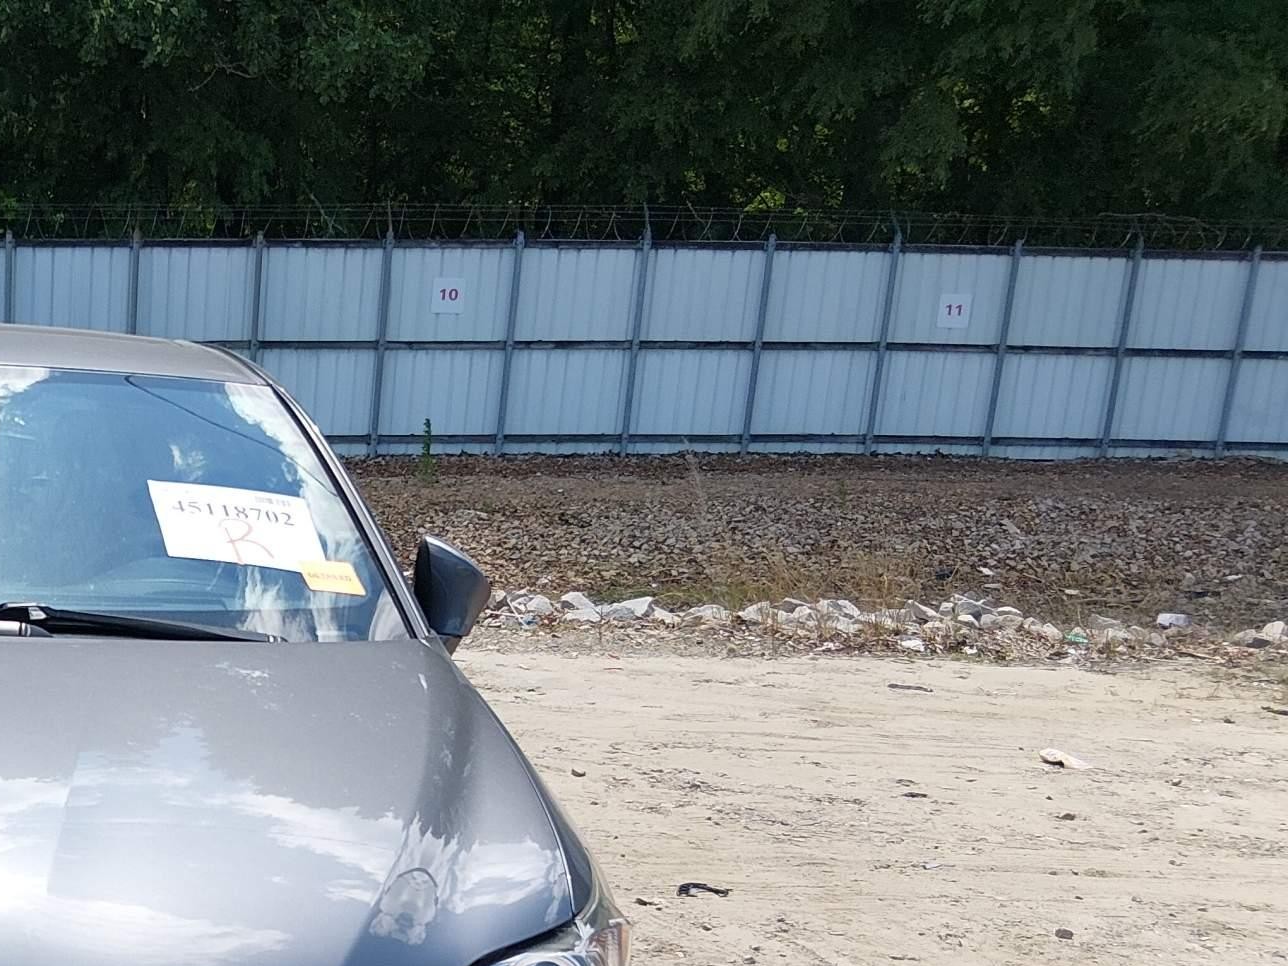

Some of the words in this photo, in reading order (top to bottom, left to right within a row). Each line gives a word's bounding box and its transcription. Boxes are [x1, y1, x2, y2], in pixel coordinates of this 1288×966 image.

[438, 288, 460, 301] 10
[944, 303, 964, 317] 11
[171, 499, 296, 527] 45118702
[217, 517, 275, 566] R
